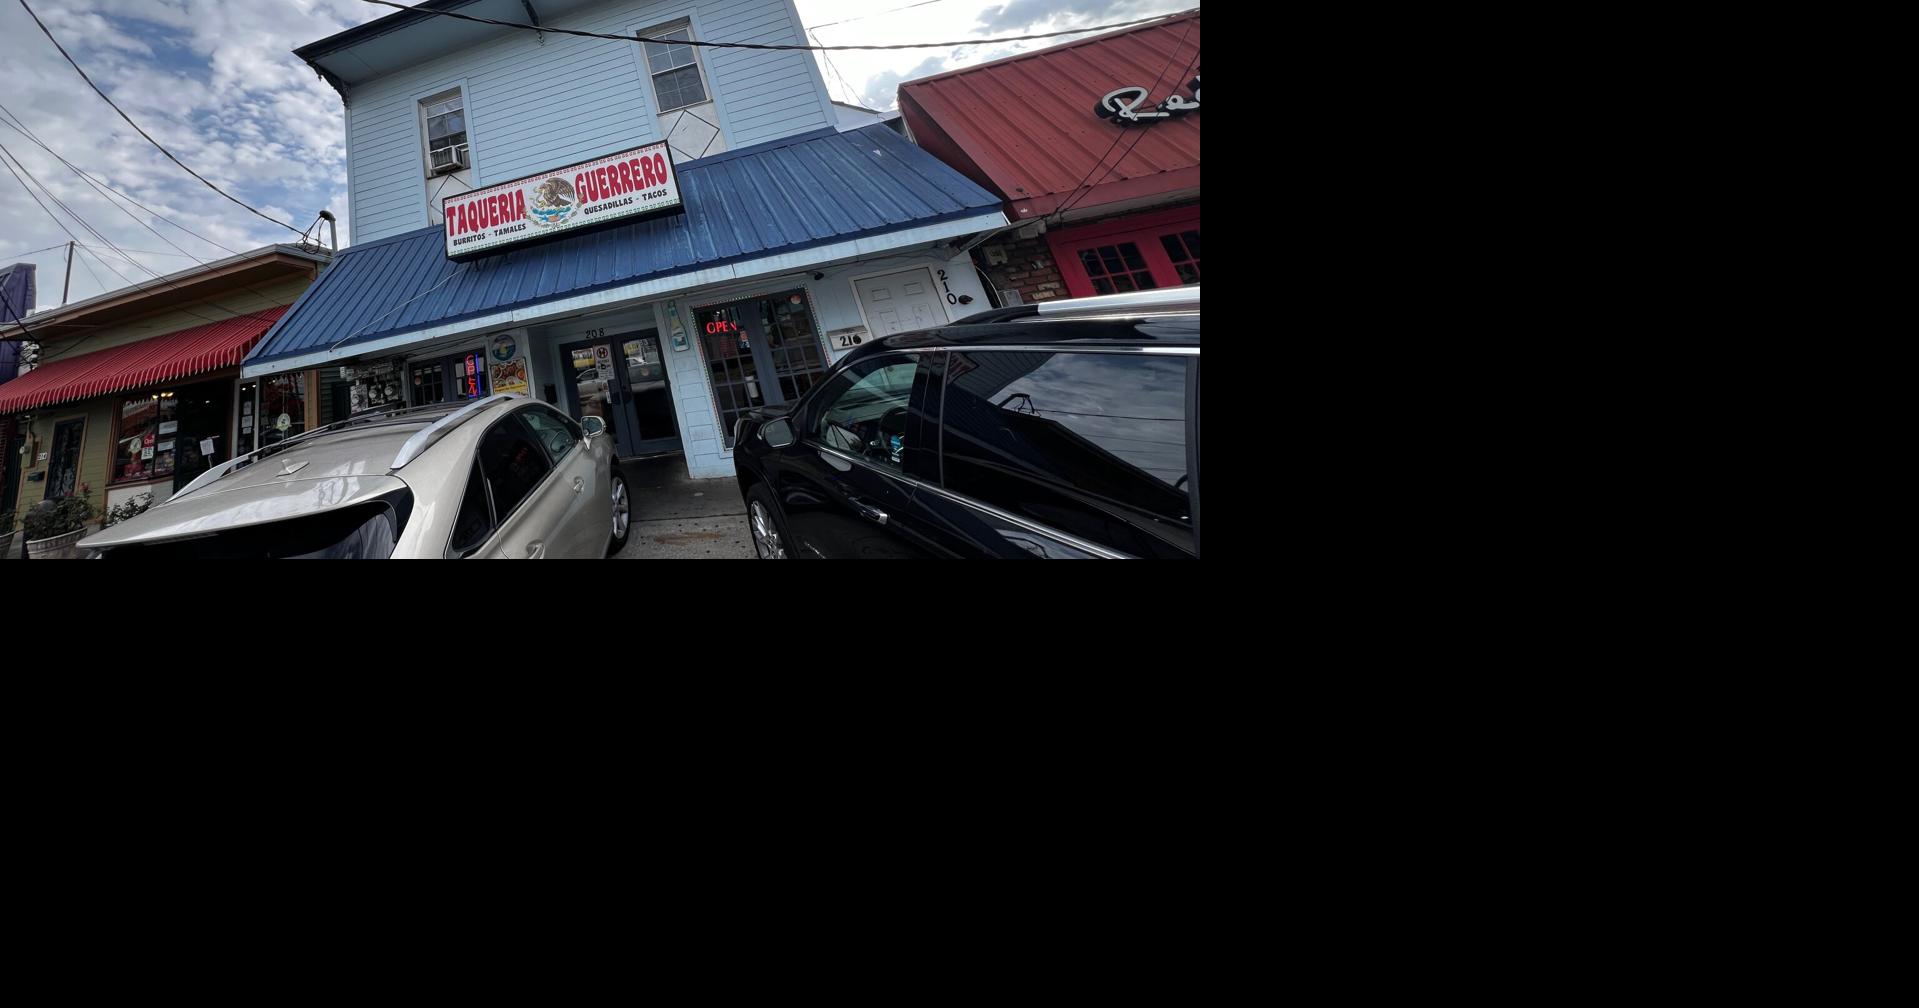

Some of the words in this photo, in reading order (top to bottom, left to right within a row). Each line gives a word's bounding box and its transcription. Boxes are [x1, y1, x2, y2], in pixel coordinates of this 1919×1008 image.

[446, 188, 527, 237] TAQUERIA
[575, 152, 668, 205] GUERRERO
[584, 197, 633, 215] QUESADILLAS
[642, 188, 668, 201] TACOS
[453, 232, 486, 247] BURRITOS
[493, 223, 527, 237] TAMALES
[937, 269, 958, 305] 210
[585, 327, 605, 339] 208
